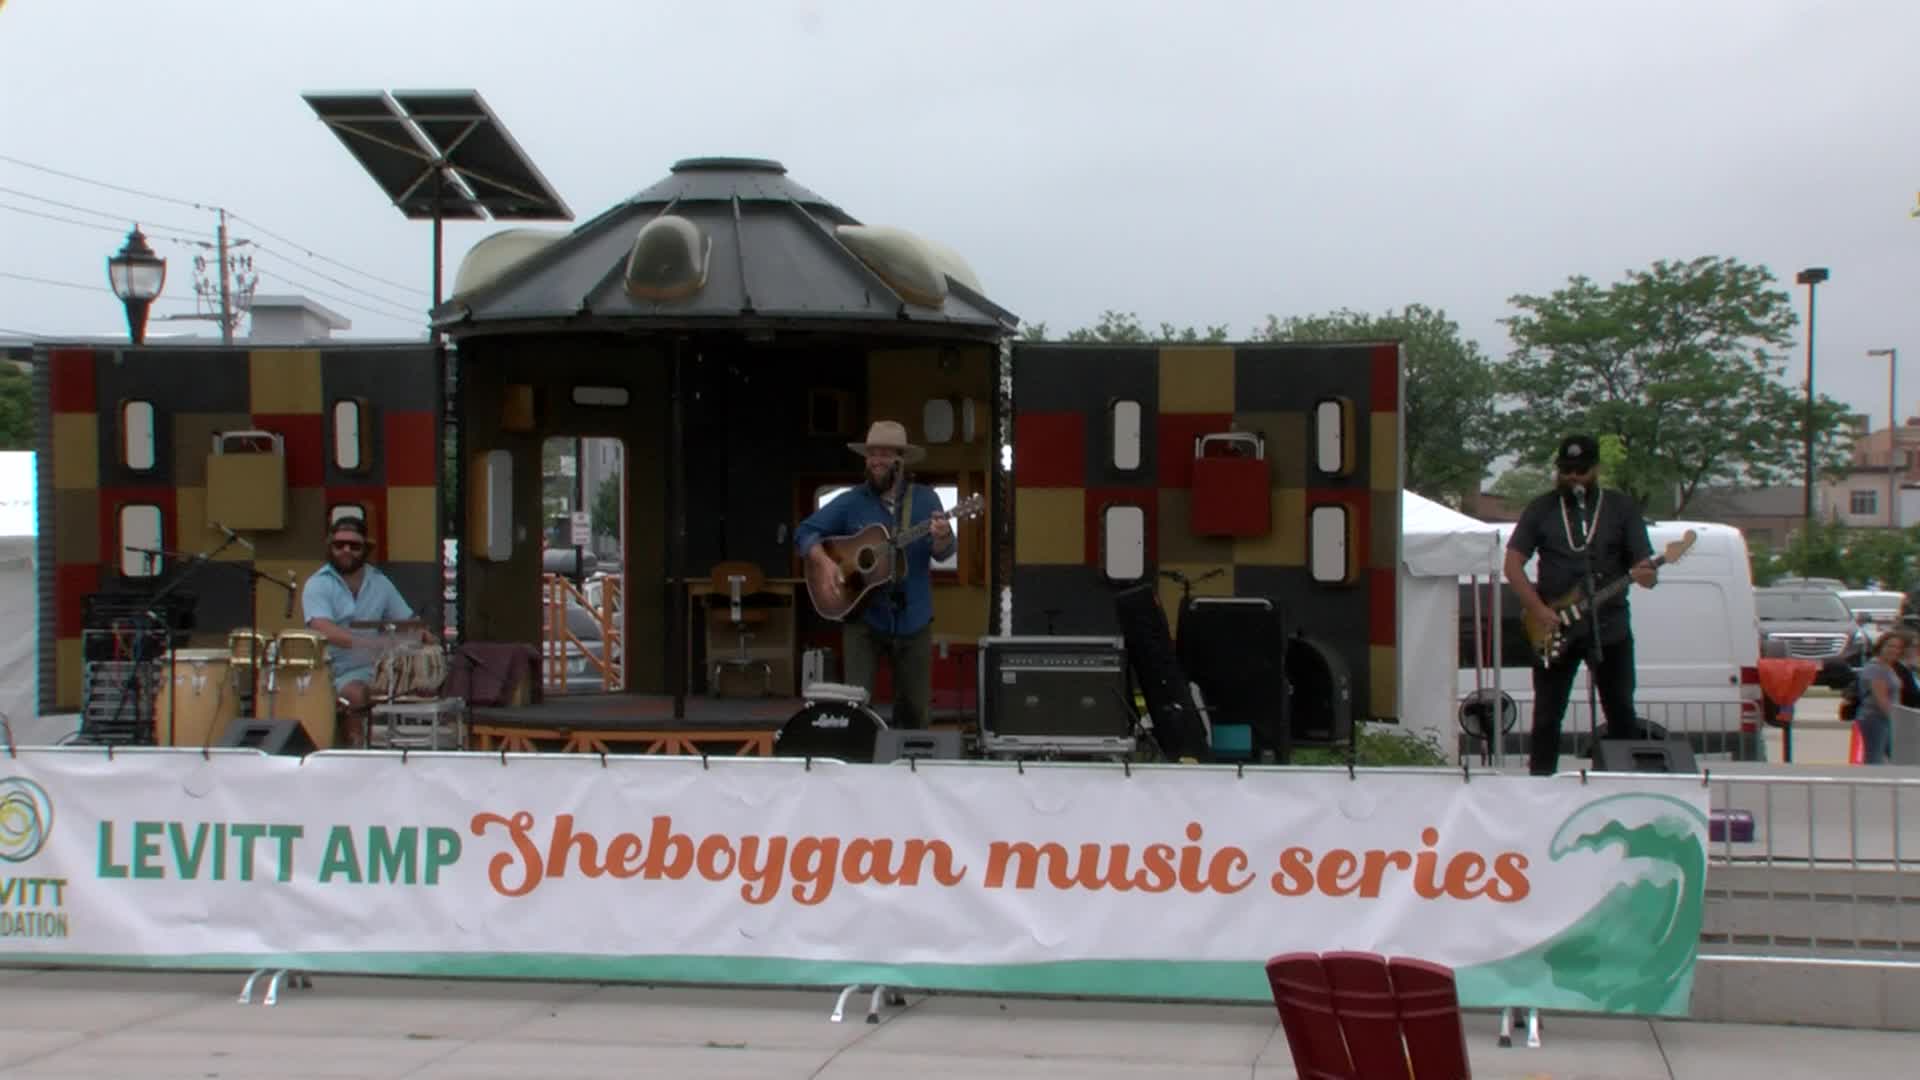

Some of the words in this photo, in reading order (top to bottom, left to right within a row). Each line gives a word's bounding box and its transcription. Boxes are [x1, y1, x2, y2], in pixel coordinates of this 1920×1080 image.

[95, 820, 304, 882] LEVITT
[318, 825, 463, 886] AMP
[470, 810, 968, 906] Sheboygan
[983, 821, 1257, 895] music
[1270, 826, 1531, 903] series
